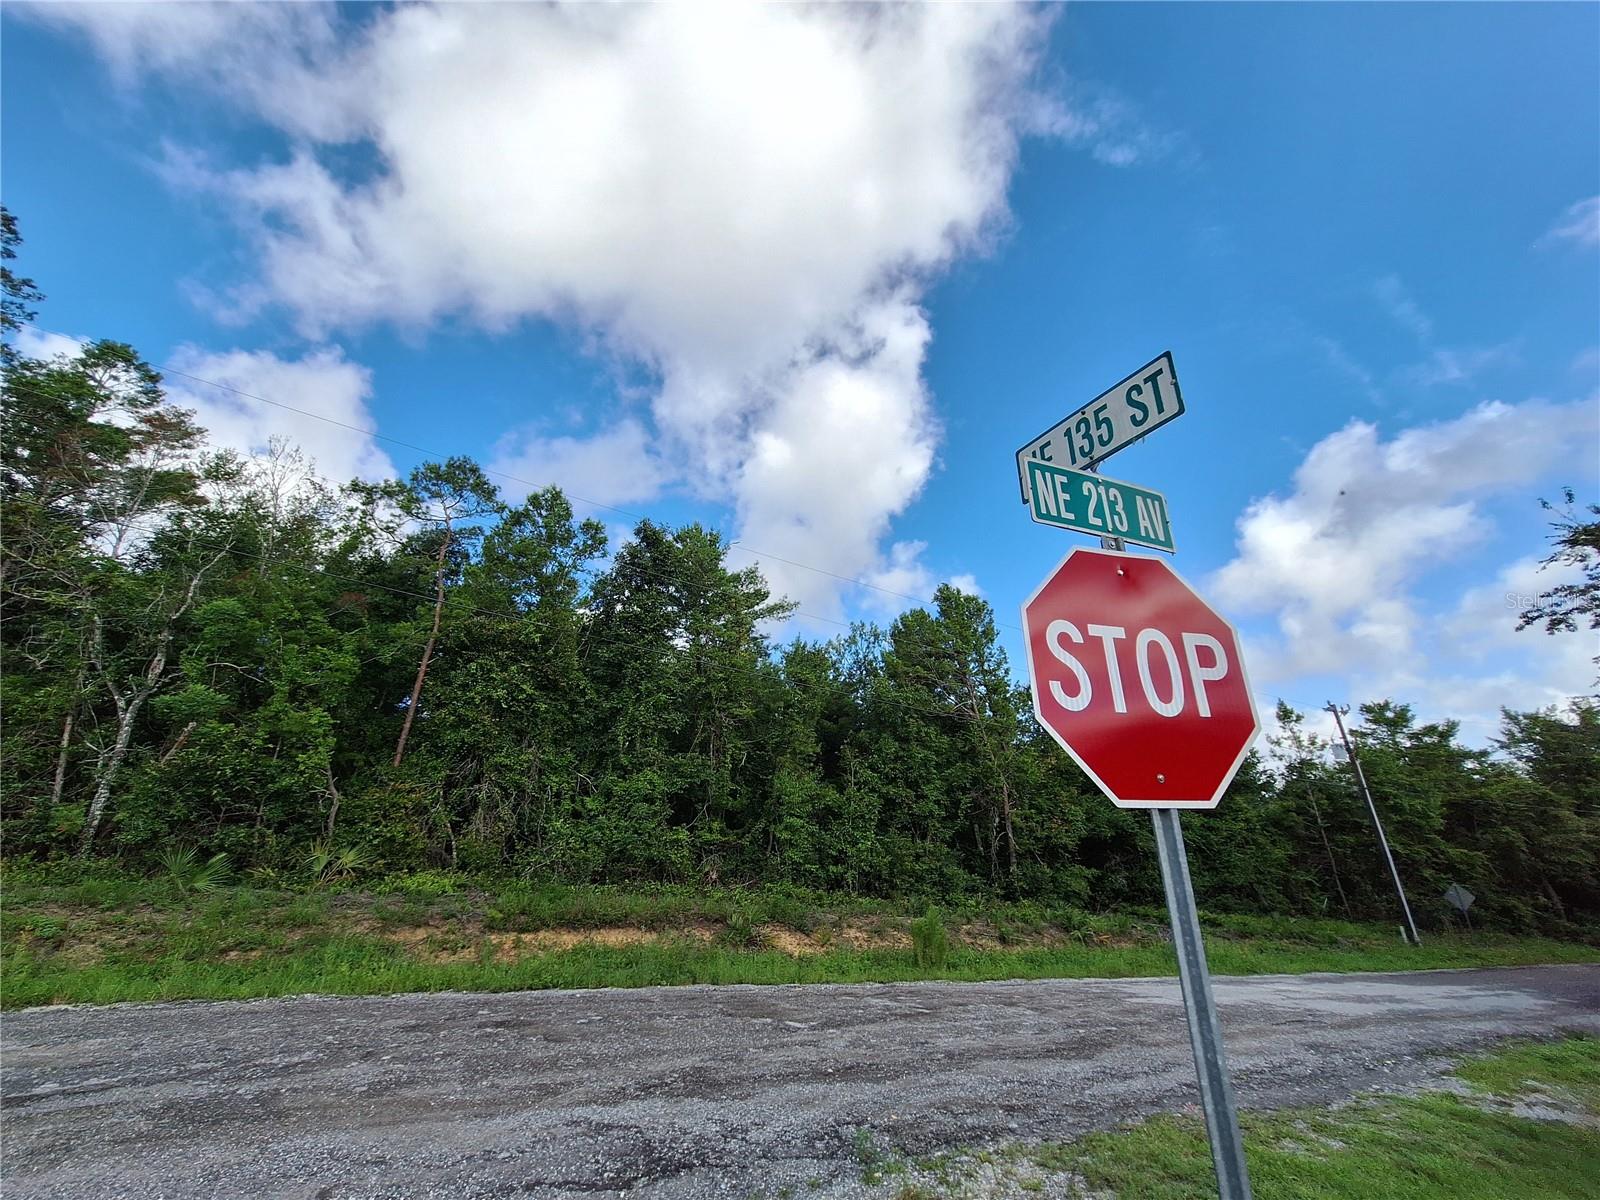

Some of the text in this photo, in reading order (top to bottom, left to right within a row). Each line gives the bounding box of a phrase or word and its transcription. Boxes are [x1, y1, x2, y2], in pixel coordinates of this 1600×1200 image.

[1063, 403, 1114, 466] 135
[1125, 367, 1164, 428] ST
[1034, 469, 1166, 542] NE 213 AV
[1045, 619, 1229, 718] STOP
